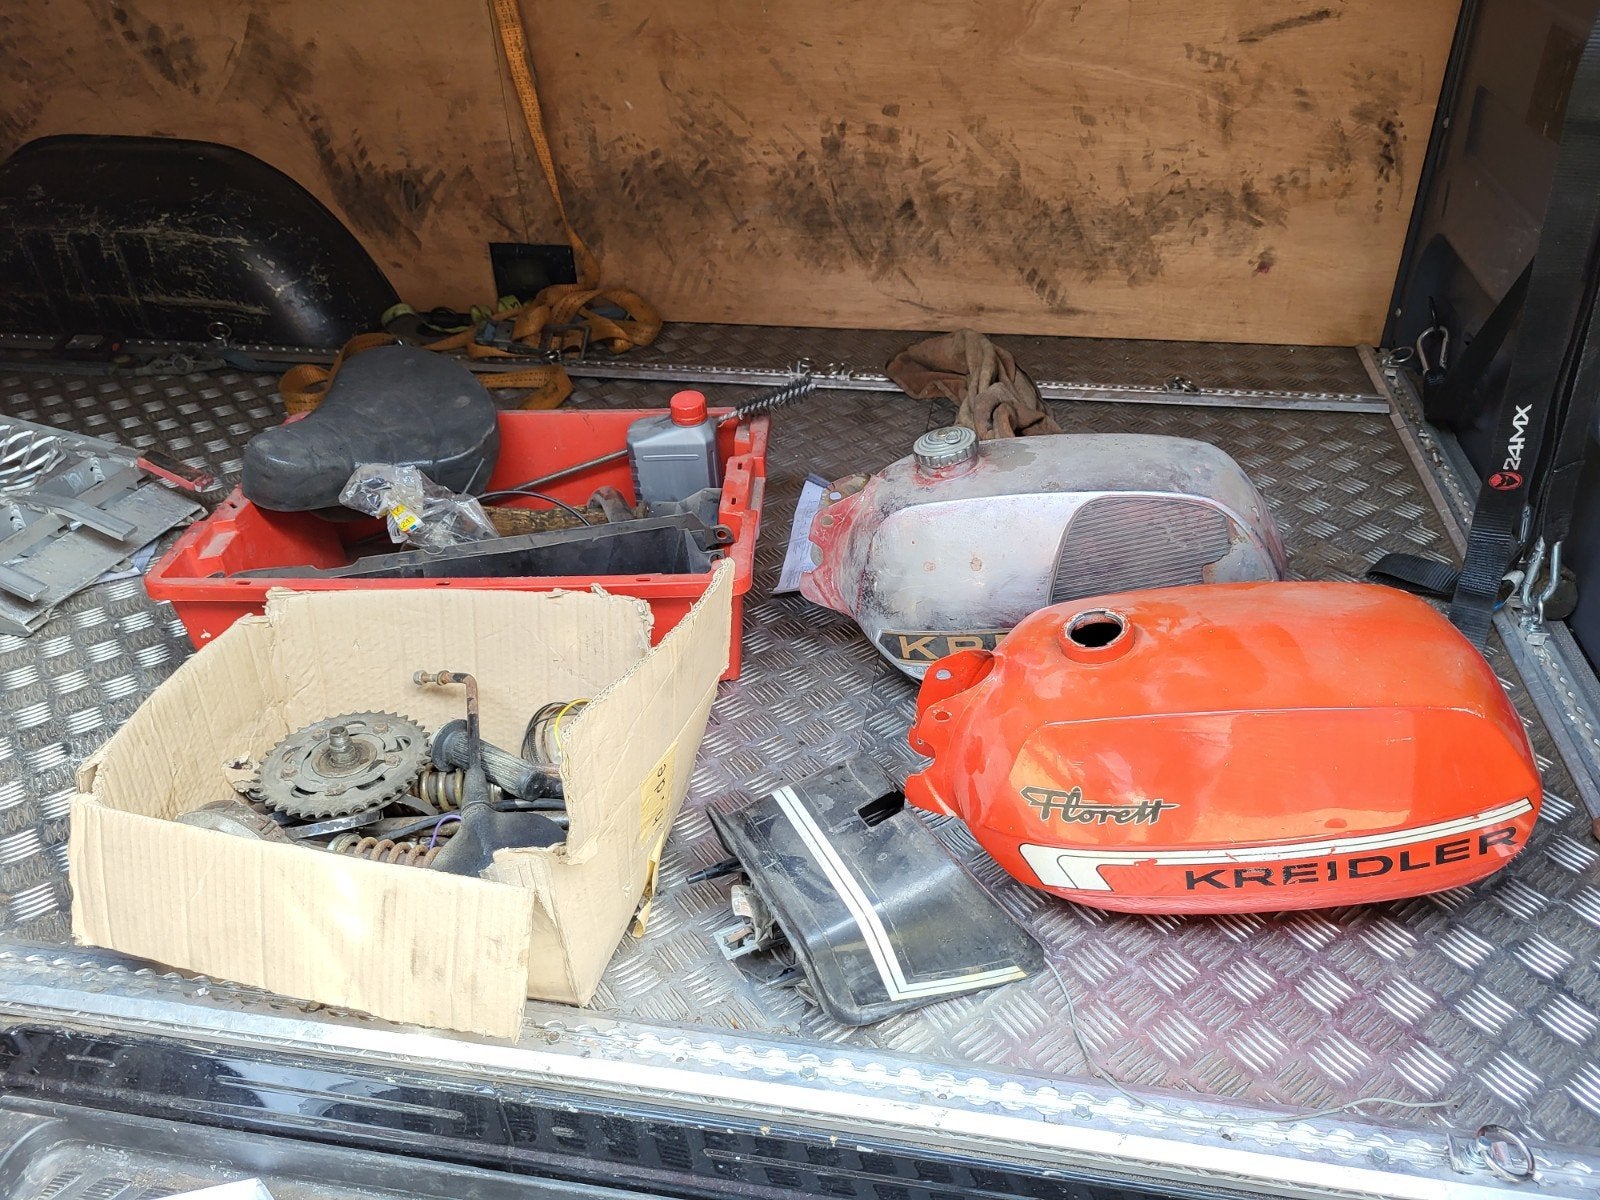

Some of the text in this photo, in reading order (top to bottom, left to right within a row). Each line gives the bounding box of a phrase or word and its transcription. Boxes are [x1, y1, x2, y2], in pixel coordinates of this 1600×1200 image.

[1503, 404, 1533, 470] 24MX
[898, 635, 1010, 660] KR
[1020, 786, 1181, 825] Florett
[1186, 826, 1519, 890] KREIDLER
